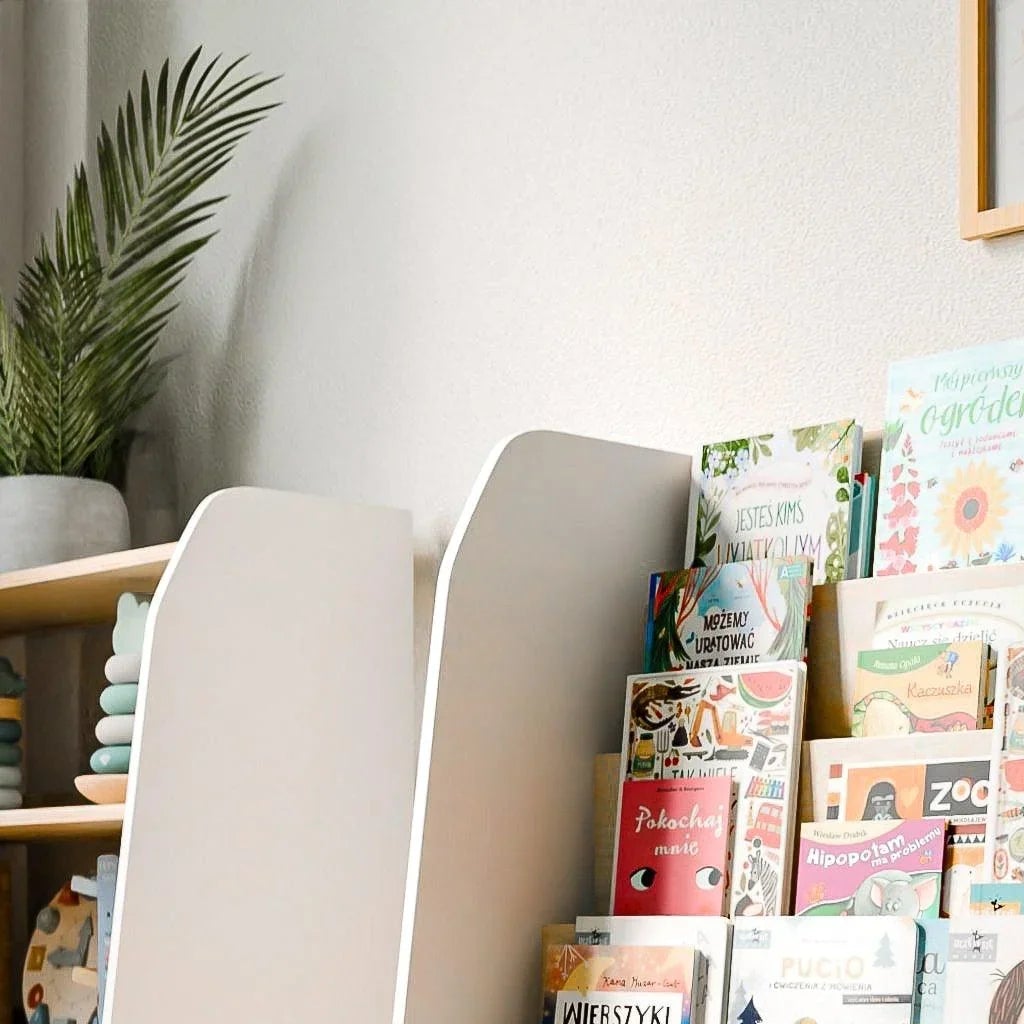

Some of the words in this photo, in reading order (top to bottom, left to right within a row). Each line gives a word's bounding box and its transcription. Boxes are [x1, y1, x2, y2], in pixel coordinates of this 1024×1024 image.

[696, 628, 755, 654] URATOWAĆ
[907, 680, 972, 698] Kaczuszka
[635, 804, 724, 838] Pokochaj
[654, 833, 699, 856] mnie
